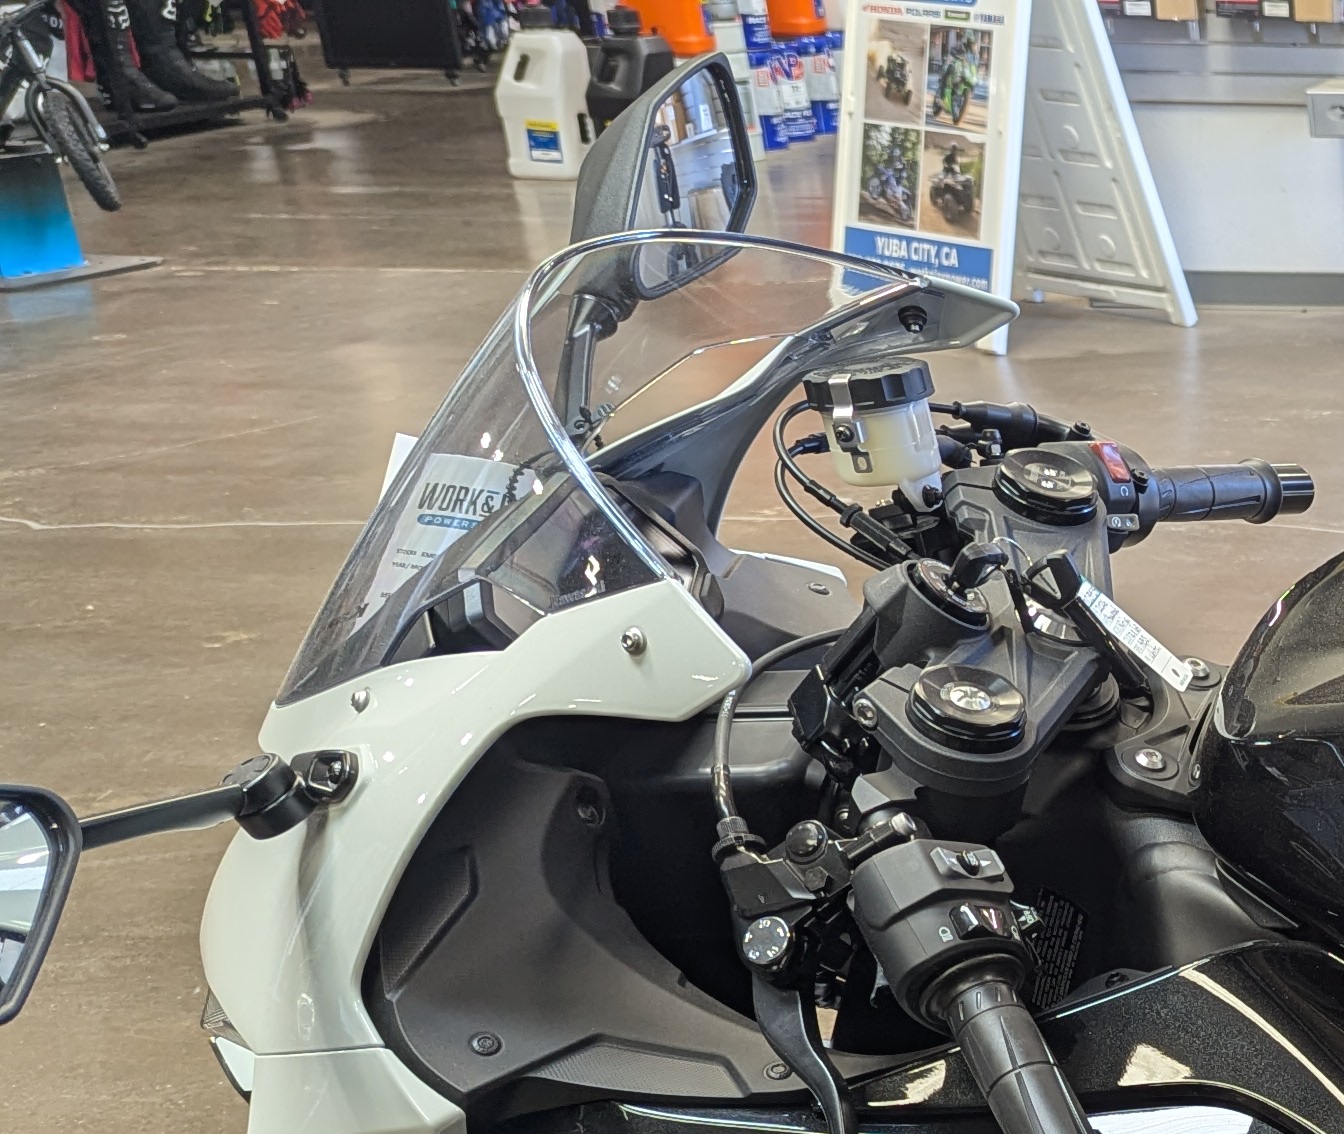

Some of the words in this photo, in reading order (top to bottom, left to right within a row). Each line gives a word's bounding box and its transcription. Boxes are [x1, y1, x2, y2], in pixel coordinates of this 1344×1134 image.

[875, 236, 909, 260] YUBA
[911, 242, 940, 267] CITY,
[941, 246, 959, 268] CA
